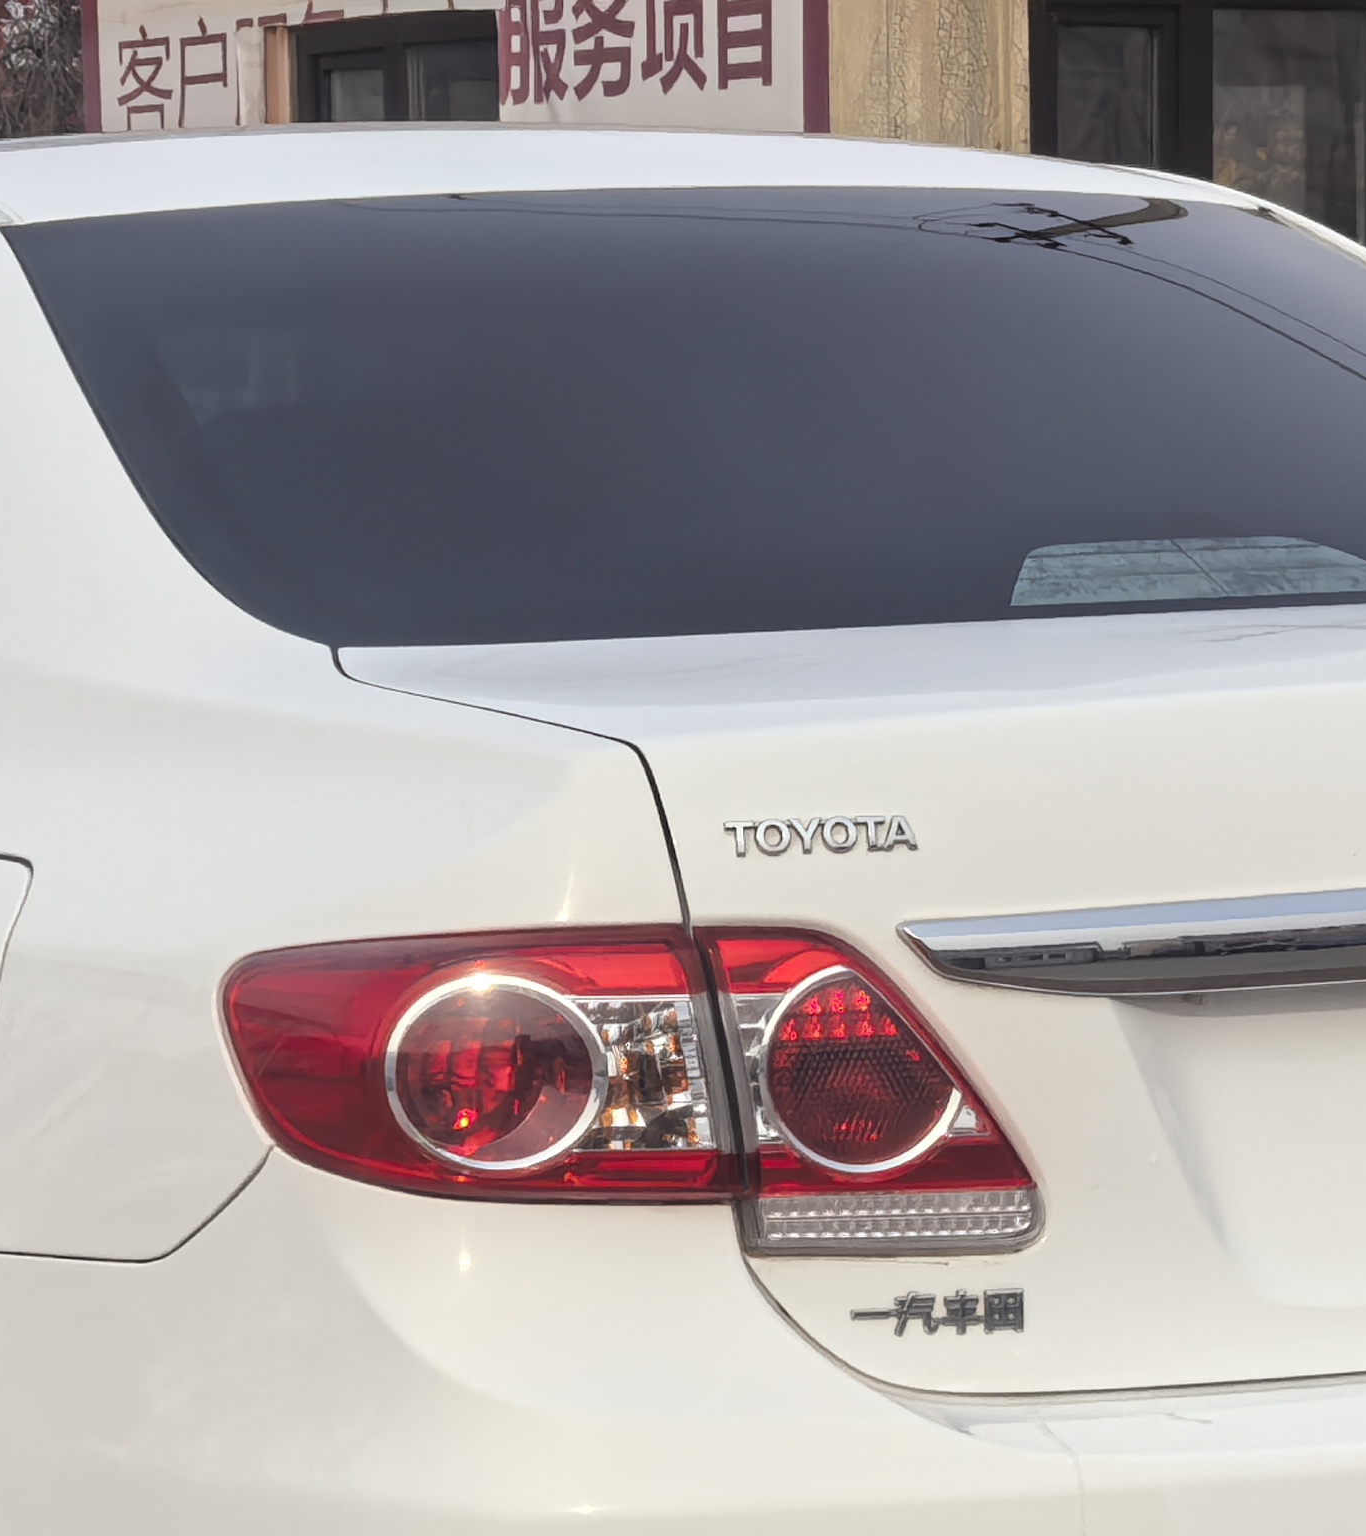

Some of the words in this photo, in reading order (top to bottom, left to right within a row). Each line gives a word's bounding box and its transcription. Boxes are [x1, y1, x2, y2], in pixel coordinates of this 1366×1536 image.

[498, 0, 773, 106] 服务项目
[724, 815, 919, 857] TOYOTA
